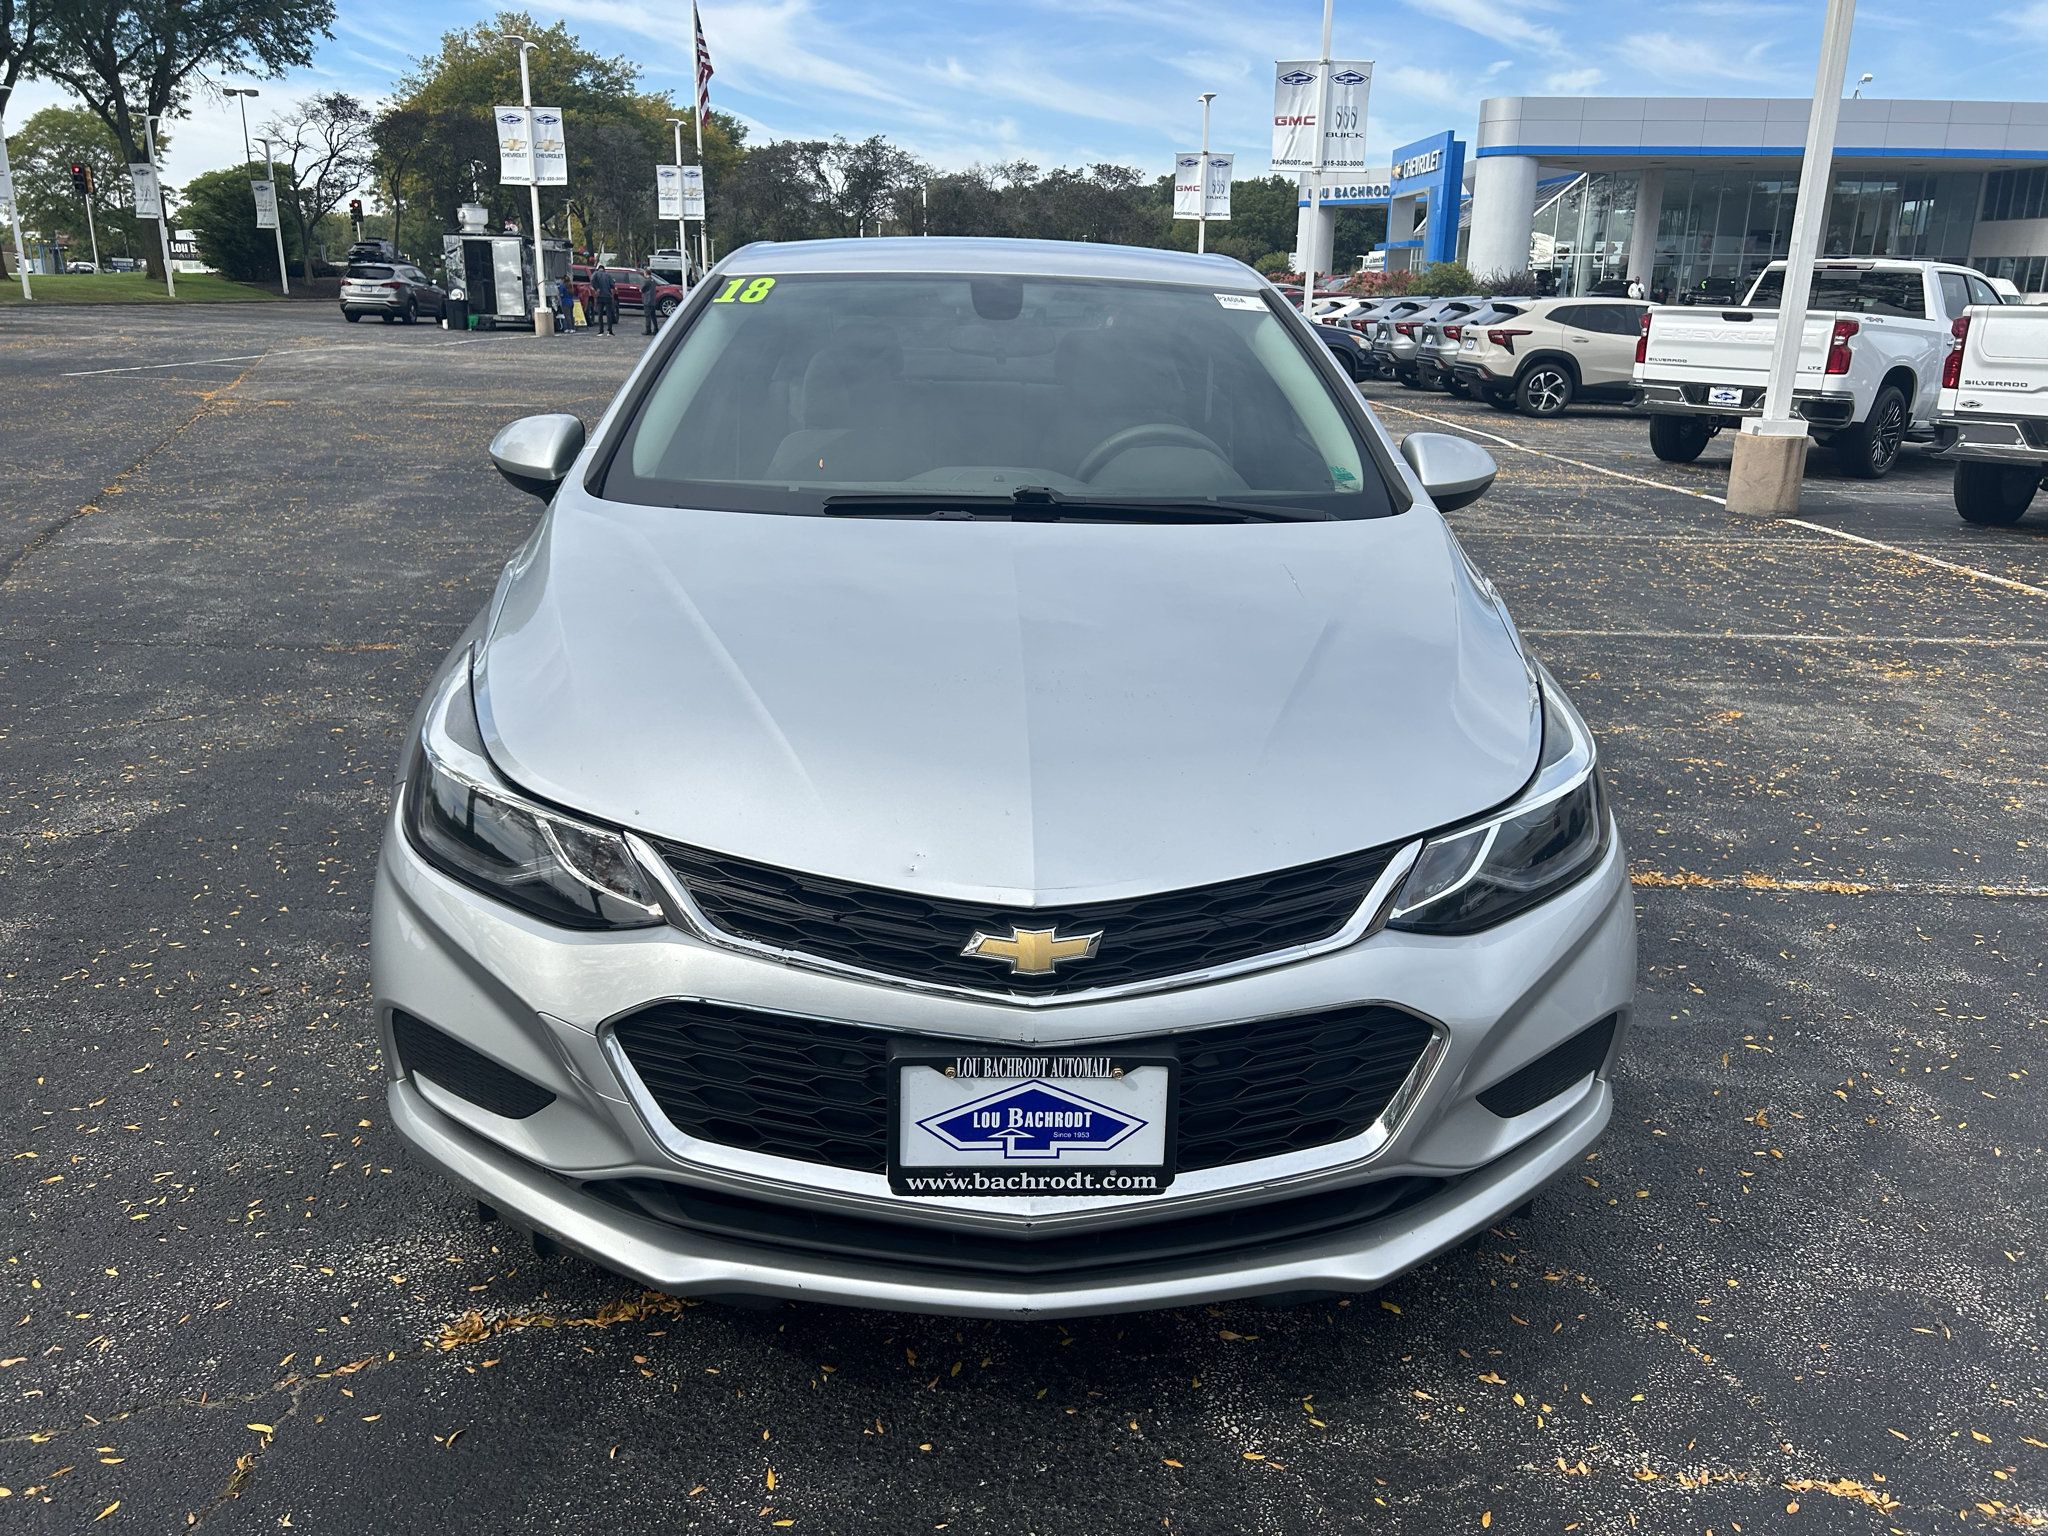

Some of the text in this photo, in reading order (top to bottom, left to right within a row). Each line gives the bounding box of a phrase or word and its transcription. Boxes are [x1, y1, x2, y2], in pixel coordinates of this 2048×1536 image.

[1274, 115, 1316, 126] GMC
[1325, 131, 1364, 139] BUICK
[1403, 149, 1442, 179] CHEVROLET
[1308, 184, 1390, 199] LU BACHROD
[170, 241, 188, 253] Lou
[713, 277, 776, 303] 18
[1964, 379, 2029, 388] SILVERADO
[956, 1057, 1113, 1078] LOU BACHRODT AUTOMALL
[973, 1111, 1000, 1128] LOU
[906, 1172, 1158, 1190] www.bachrodt.com
